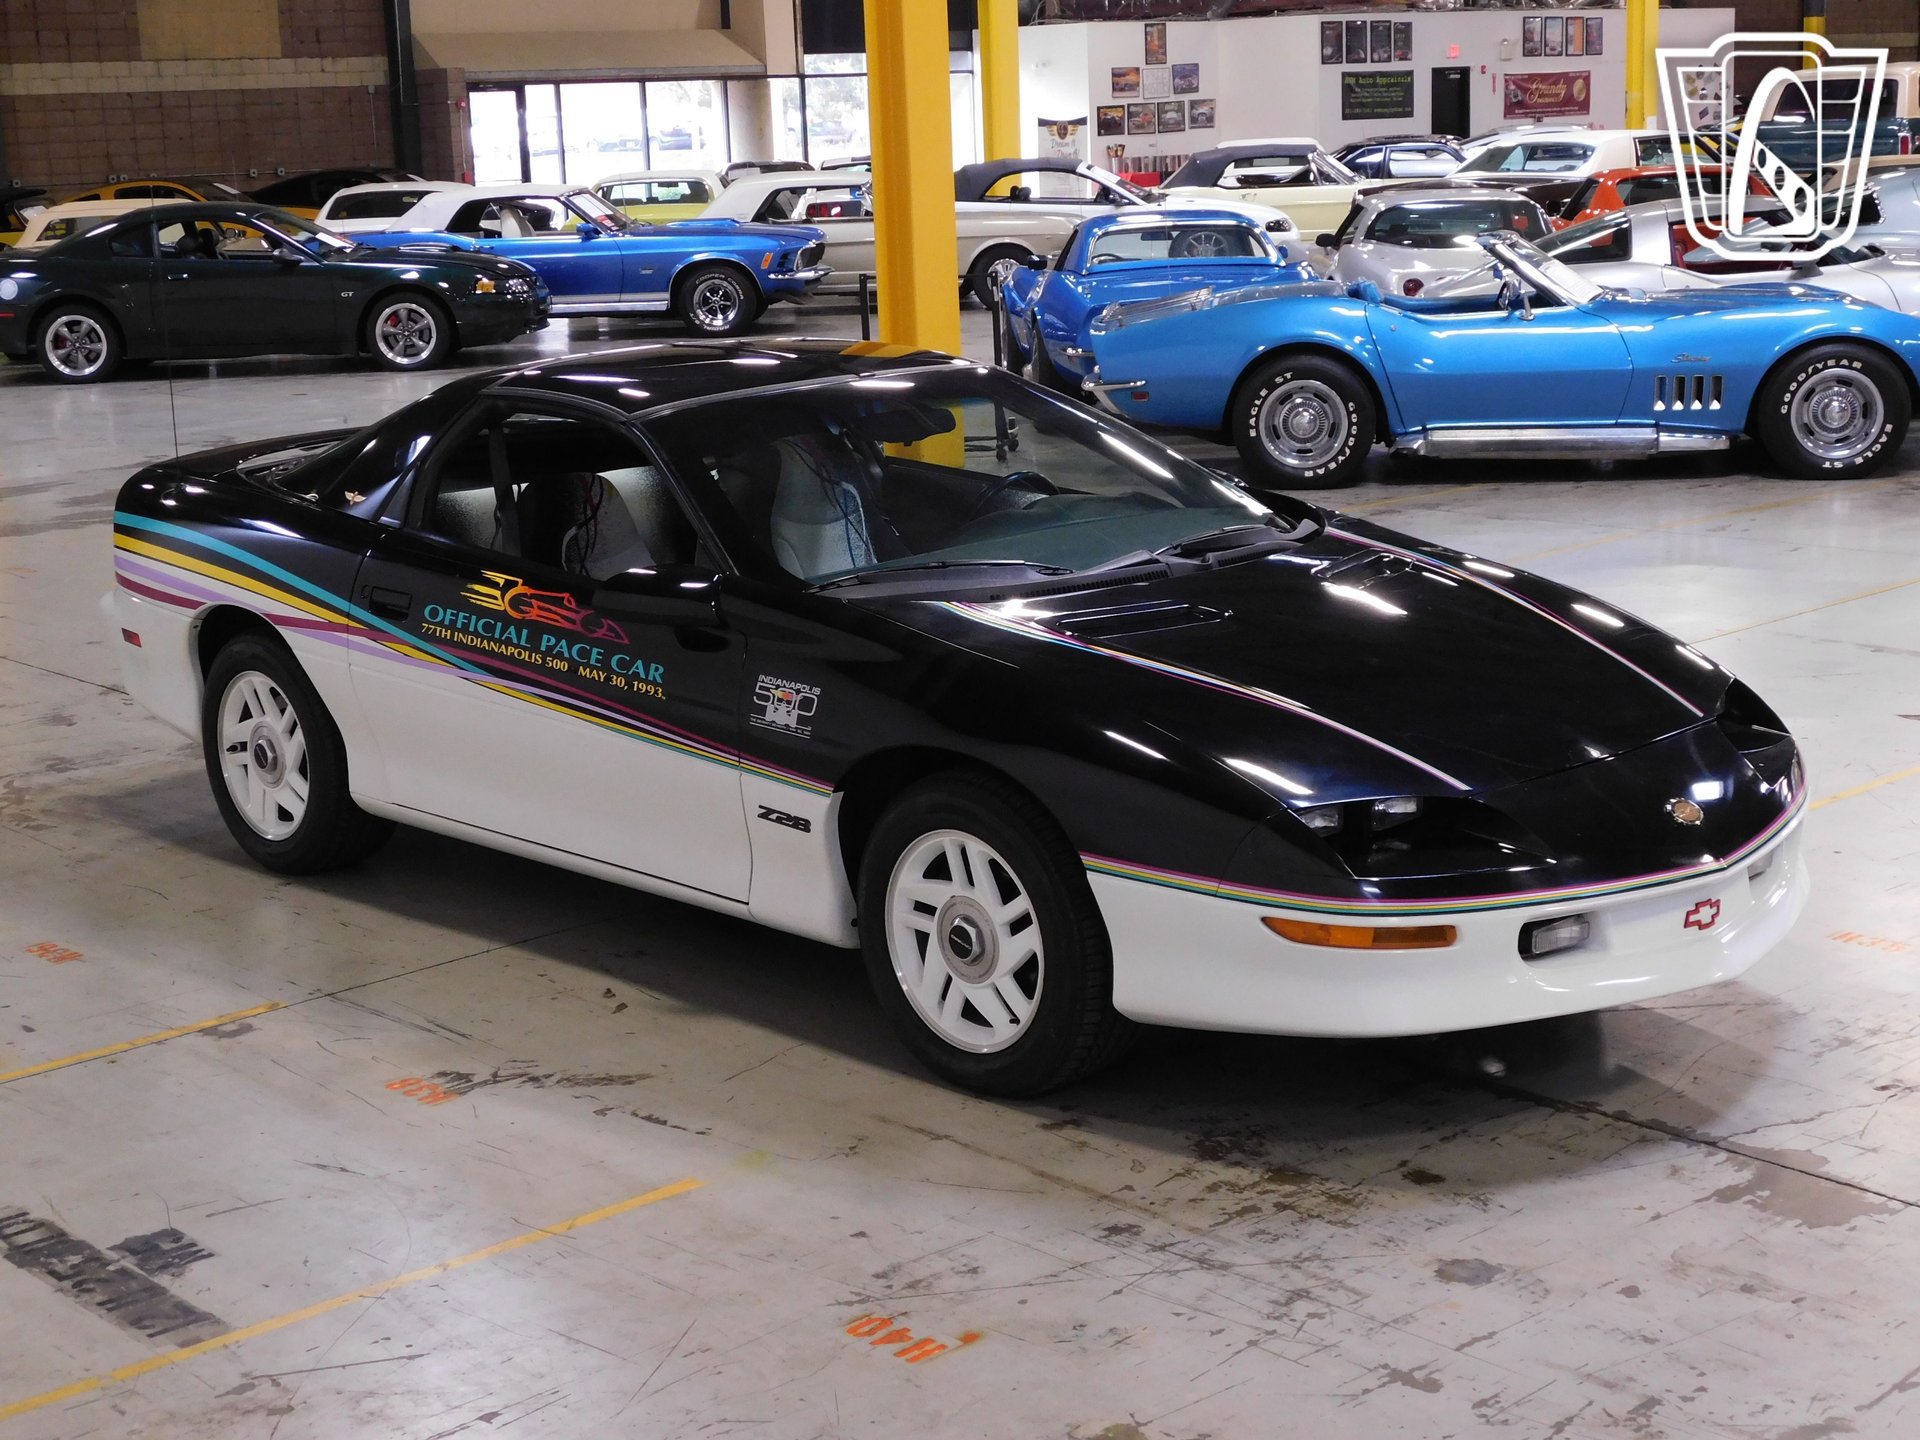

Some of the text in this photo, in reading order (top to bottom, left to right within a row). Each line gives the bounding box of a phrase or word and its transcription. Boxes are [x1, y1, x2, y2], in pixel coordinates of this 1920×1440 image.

[695, 273, 744, 300] COOPER COBRA
[1248, 371, 1294, 438] EAGLE ST
[1780, 359, 1863, 415] GOODYEAR
[1304, 401, 1358, 478] GOODYEAR
[1854, 424, 1893, 465] EAGLE
[421, 622, 451, 640] 77TH
[453, 631, 543, 665] INDIANAPOLIS
[545, 658, 568, 673] 500
[577, 665, 607, 683] MAY
[609, 674, 628, 691] 30,
[424, 604, 665, 683] OFFICIAL PACE CAR
[753, 682, 818, 716] 500
[758, 674, 822, 696] INDIANAPOLIS
[757, 804, 812, 834] Z28
